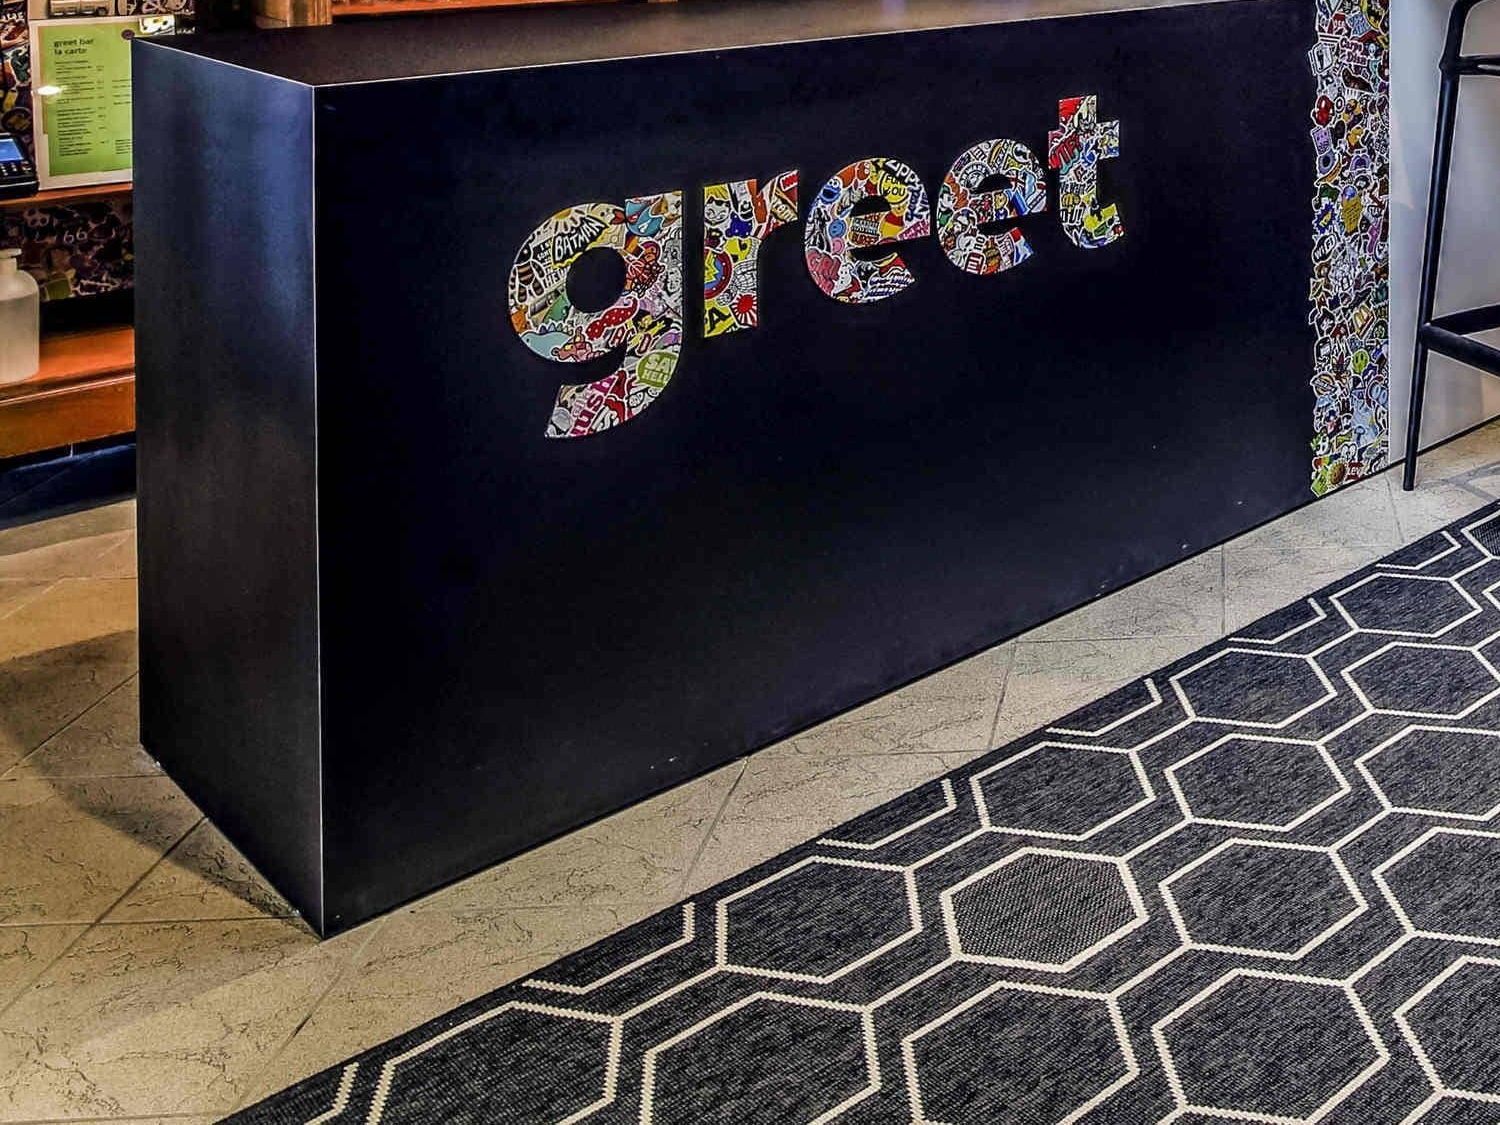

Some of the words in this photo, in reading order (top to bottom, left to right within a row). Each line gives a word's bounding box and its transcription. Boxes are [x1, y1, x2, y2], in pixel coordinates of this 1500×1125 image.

[54, 38, 78, 48] greet
[64, 47, 87, 55] carte
[555, 215, 606, 262] BATMAN
[508, 94, 1125, 438] greet
